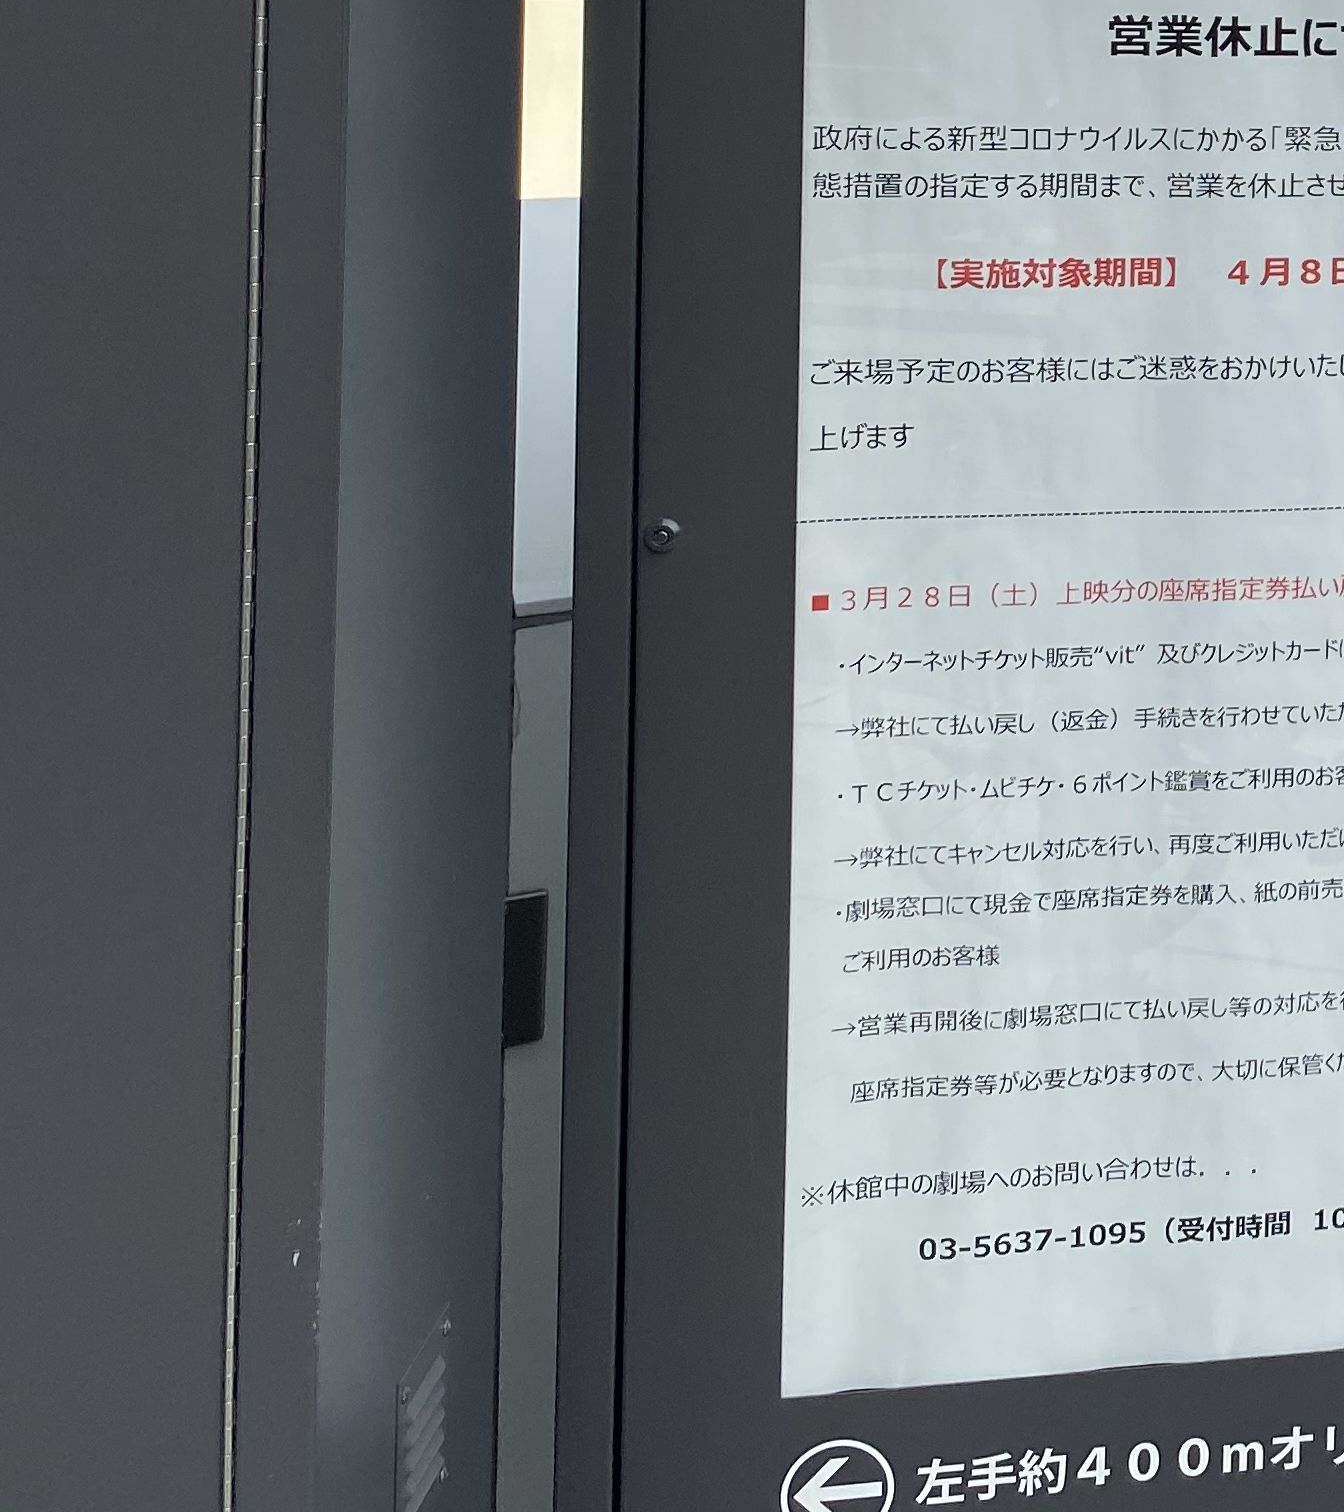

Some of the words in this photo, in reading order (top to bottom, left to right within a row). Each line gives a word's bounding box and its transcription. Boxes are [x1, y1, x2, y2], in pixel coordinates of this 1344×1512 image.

[936, 257, 1177, 290] 【実施対象期間】
[809, 422, 914, 452] 上げます
[842, 944, 1000, 974] ご利用のお客様
